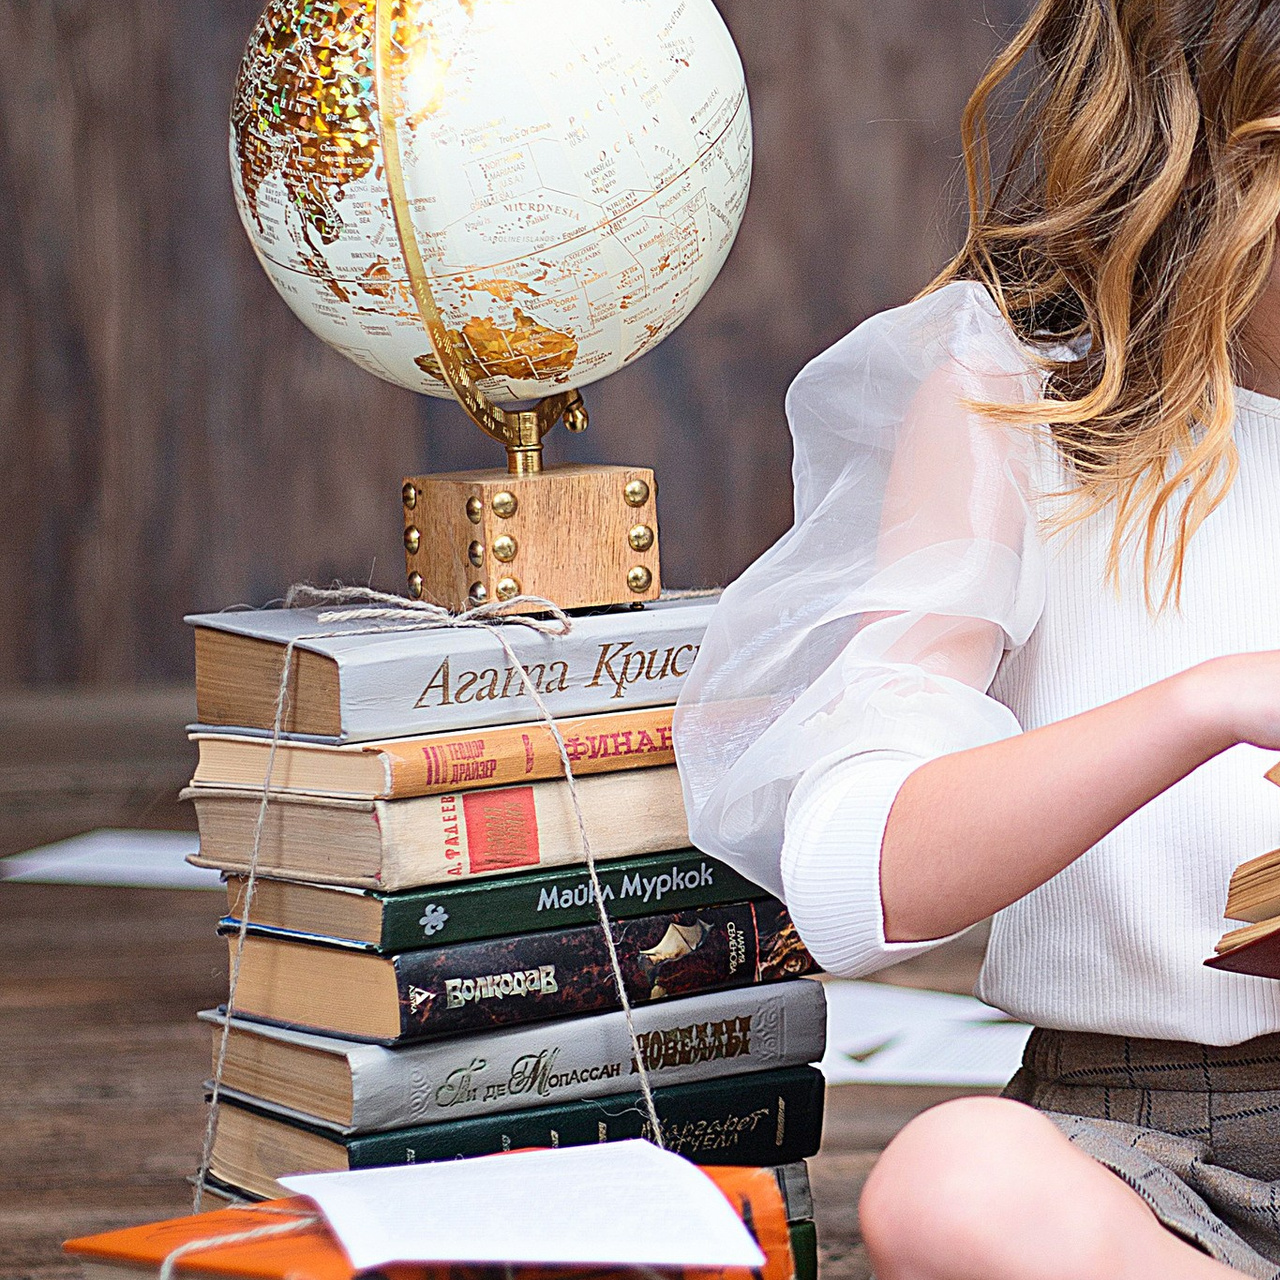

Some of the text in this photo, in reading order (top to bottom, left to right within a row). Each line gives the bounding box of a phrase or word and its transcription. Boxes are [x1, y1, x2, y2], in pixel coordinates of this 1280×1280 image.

[272, 96, 312, 117] CHINA
[503, 202, 580, 221] MICRONESIA
[562, 225, 588, 240] Equator
[555, 295, 579, 308] CORAL
[562, 304, 577, 313] SEA
[412, 641, 702, 709] Агата Крис
[448, 739, 485, 761] ТЕОДОР
[450, 758, 497, 785] ДРАЙЗЕР
[537, 864, 714, 912] Майкл Муркок
[736, 930, 745, 963] МАРИЯ
